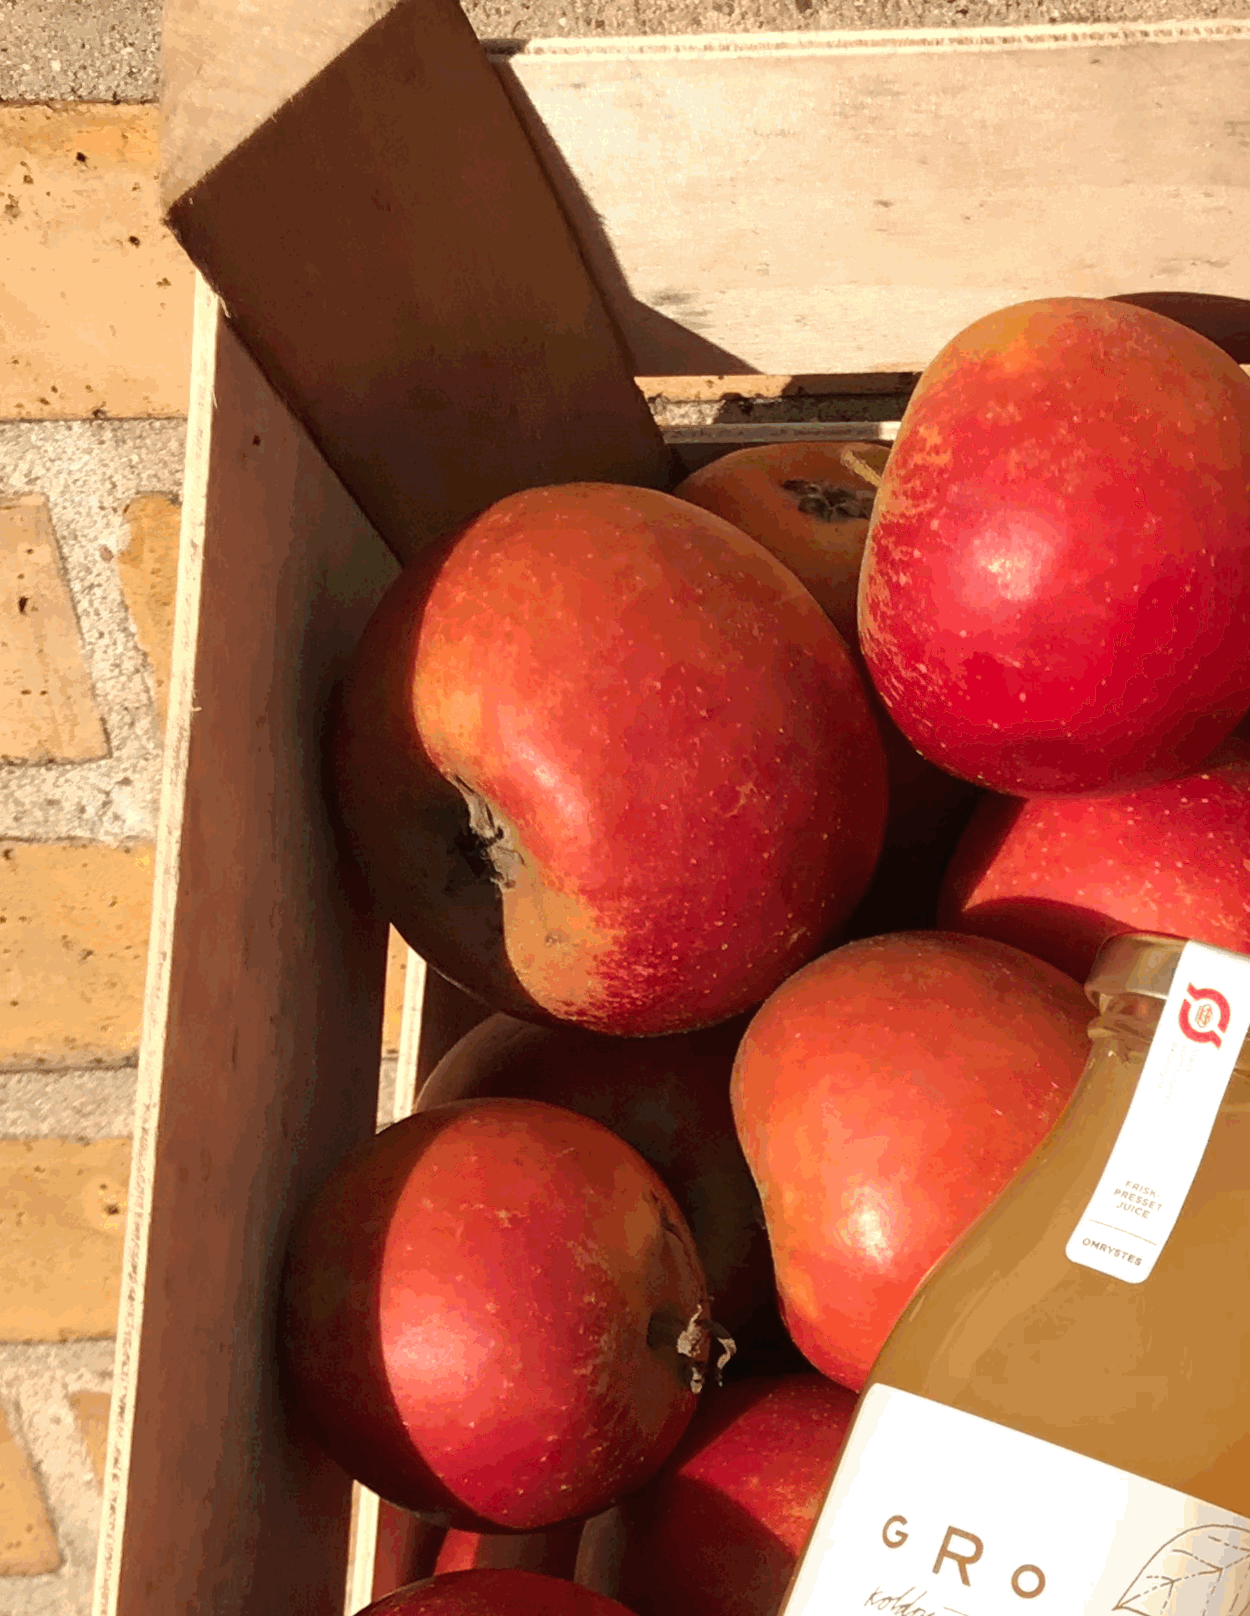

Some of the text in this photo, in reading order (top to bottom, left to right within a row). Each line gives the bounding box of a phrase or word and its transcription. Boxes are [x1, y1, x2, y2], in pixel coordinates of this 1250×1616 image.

[1113, 1188, 1162, 1211] PRESSET
[1116, 1201, 1150, 1219] JUICE
[1082, 1237, 1142, 1266] OMRYSTES
